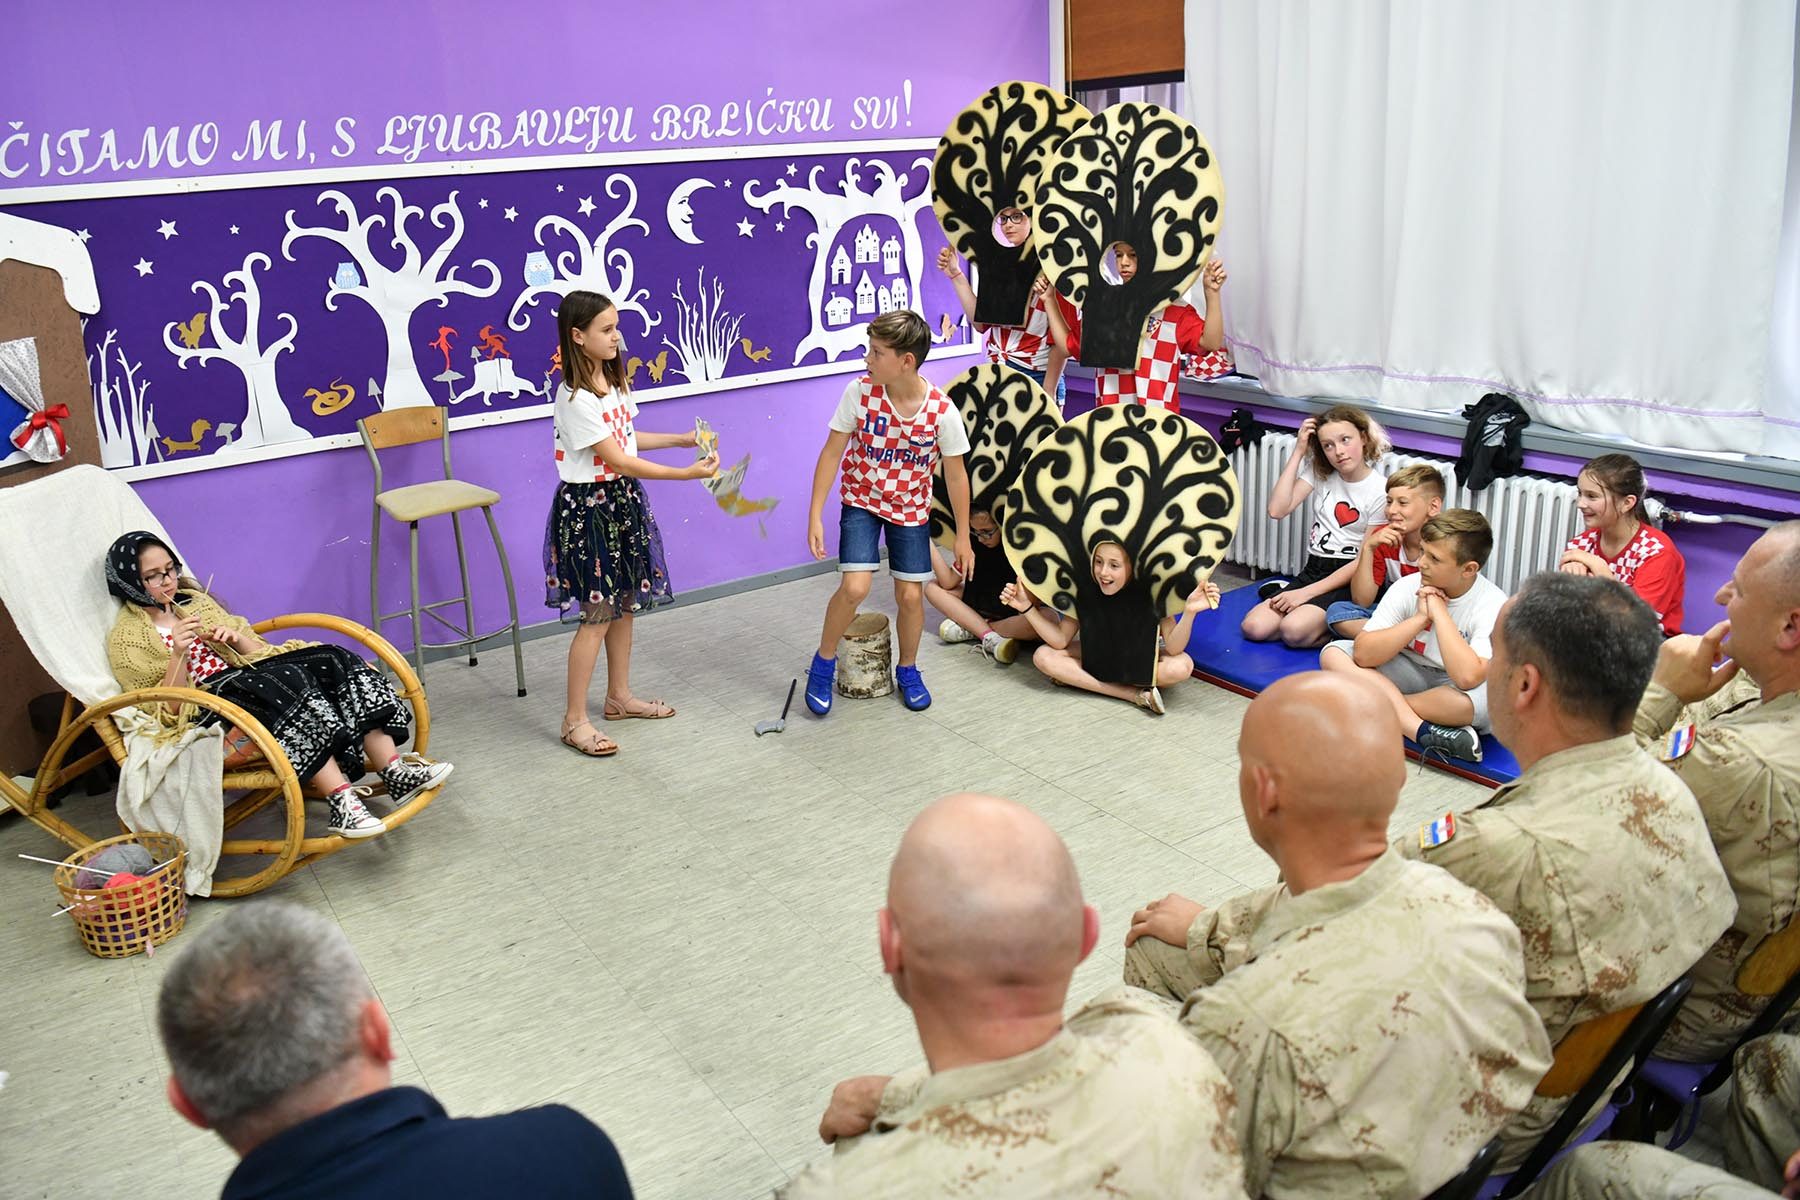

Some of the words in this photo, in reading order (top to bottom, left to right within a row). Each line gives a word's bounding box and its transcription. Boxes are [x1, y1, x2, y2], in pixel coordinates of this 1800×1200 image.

[0, 121, 219, 179] ČITAMO
[330, 116, 357, 158] S
[376, 105, 637, 163] LJUBAVLJU
[650, 86, 835, 142] BRLIĆKU
[849, 79, 914, 131] SVI!
[863, 413, 887, 436] 10
